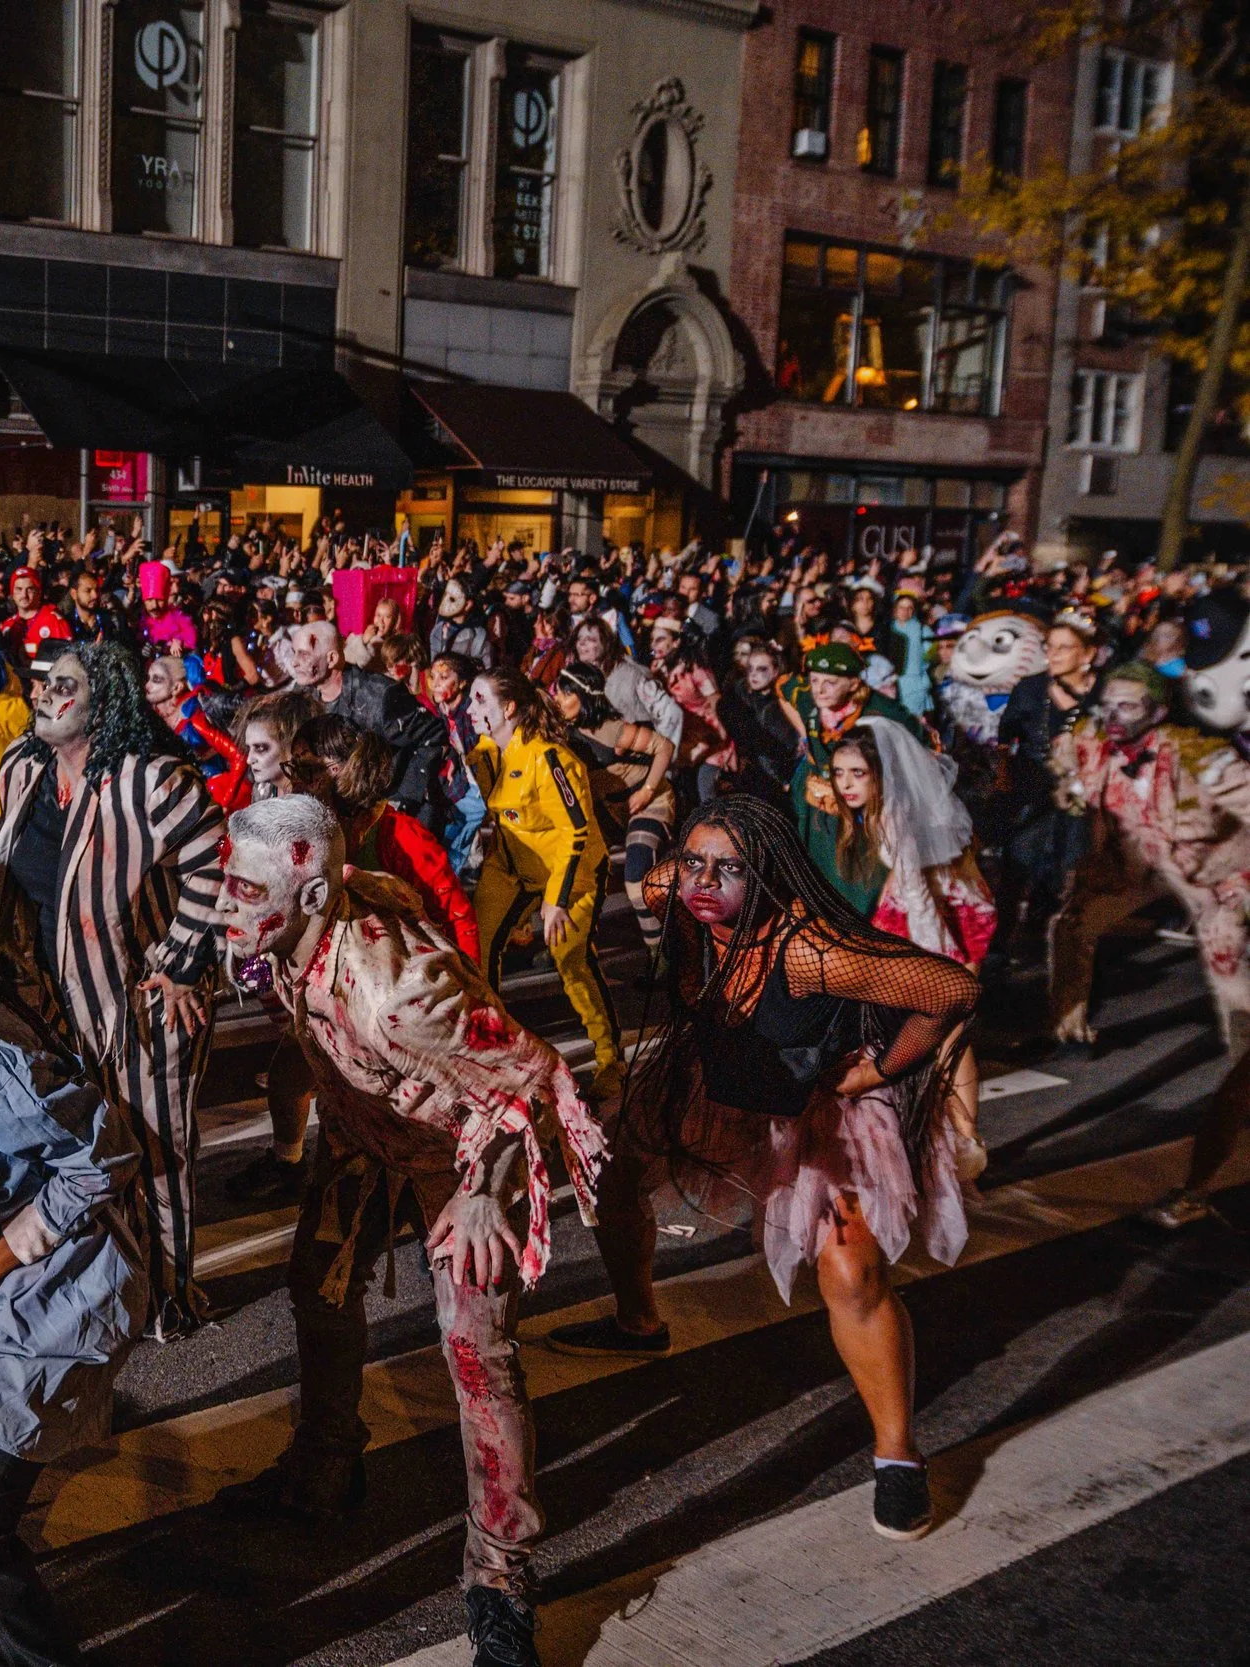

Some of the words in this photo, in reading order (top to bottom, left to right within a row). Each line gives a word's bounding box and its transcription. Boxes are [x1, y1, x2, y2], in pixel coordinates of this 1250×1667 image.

[333, 472, 374, 486] HEALTH
[496, 475, 516, 487] THE
[517, 476, 568, 489] LOCAVORE
[570, 478, 607, 490] VARIETY
[609, 479, 639, 492] STORE
